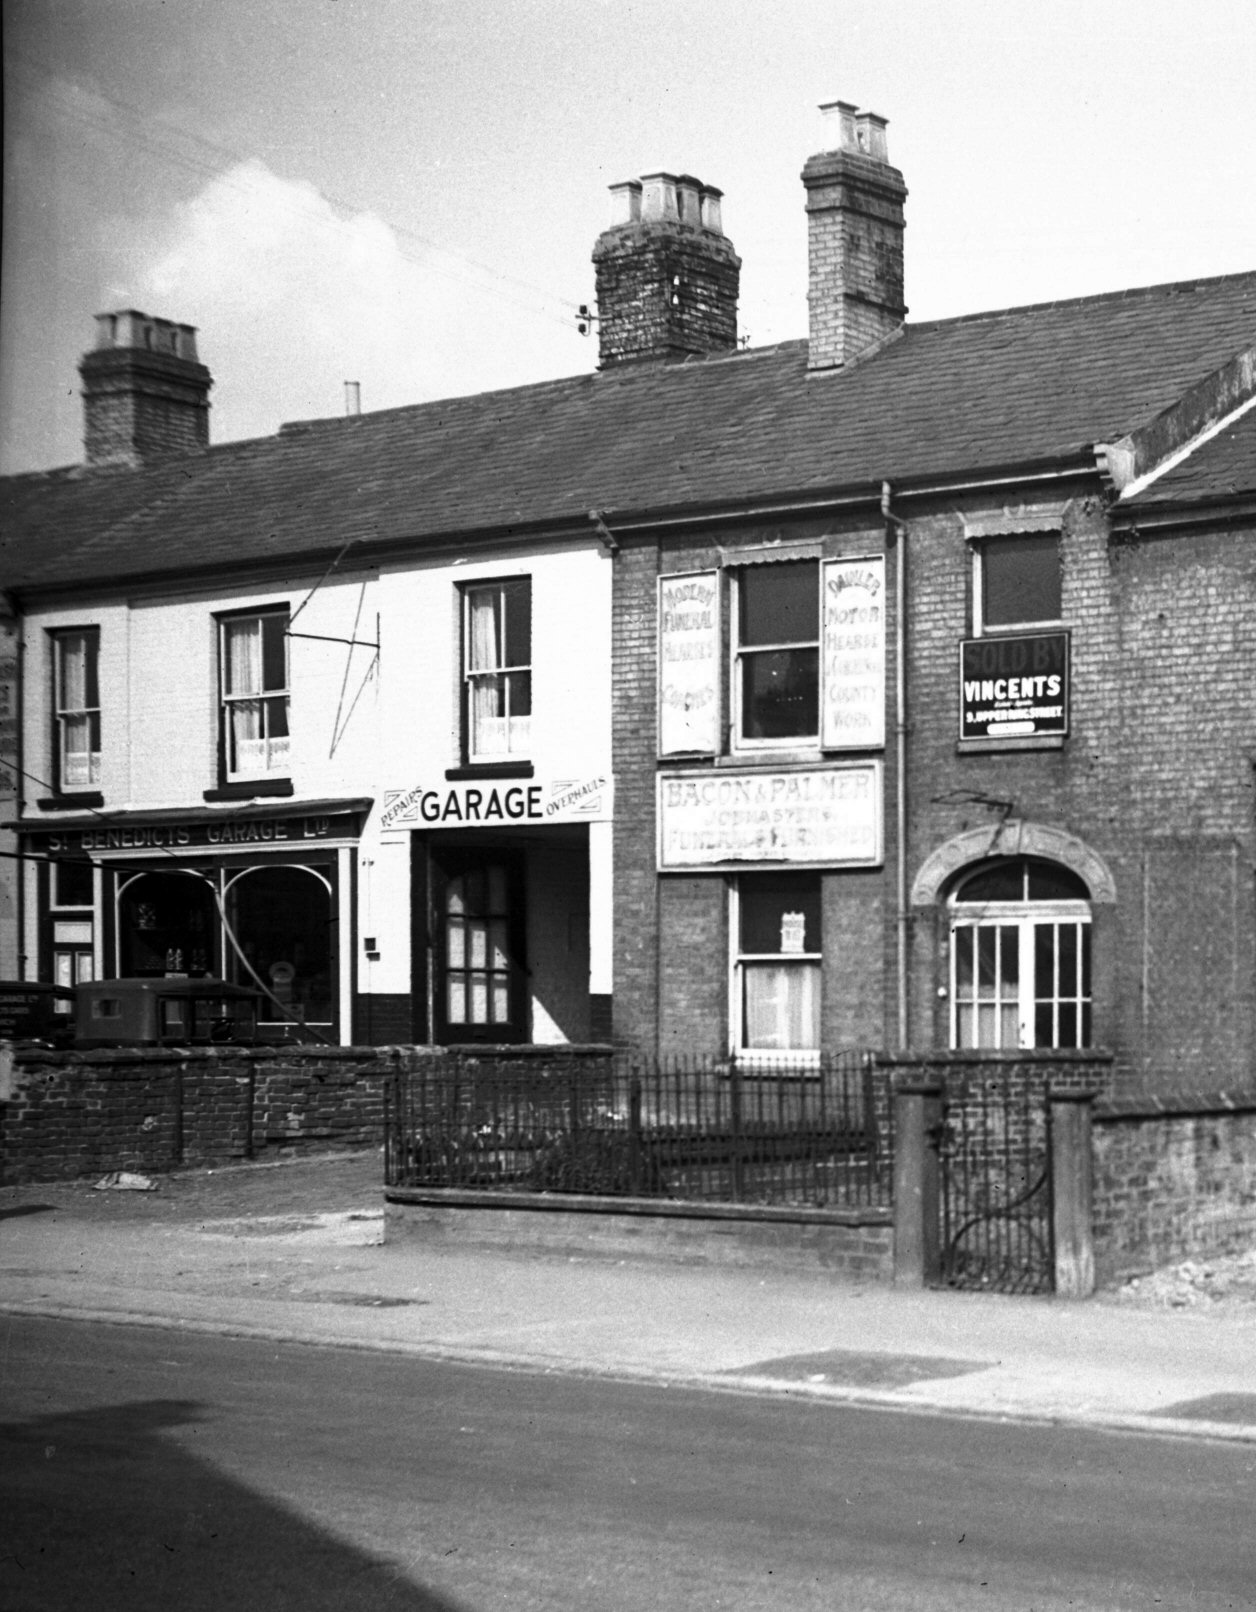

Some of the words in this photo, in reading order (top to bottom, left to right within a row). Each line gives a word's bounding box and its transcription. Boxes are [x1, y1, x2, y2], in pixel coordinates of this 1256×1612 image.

[662, 610, 713, 632] FUNERAL
[828, 605, 878, 625] MOTOR
[826, 632, 876, 651] HEARSE
[965, 642, 1027, 674] SOLD
[1033, 637, 1063, 672] BY
[964, 674, 1061, 702] VINCENTS
[380, 786, 423, 827] REPAIRS
[420, 785, 543, 822] GARAGE
[546, 777, 607, 816] OVERHAULS
[667, 780, 751, 807] BACON
[770, 774, 869, 802] PALMER
[81, 824, 191, 850] BENEDICTS
[206, 819, 288, 843] GARAGE
